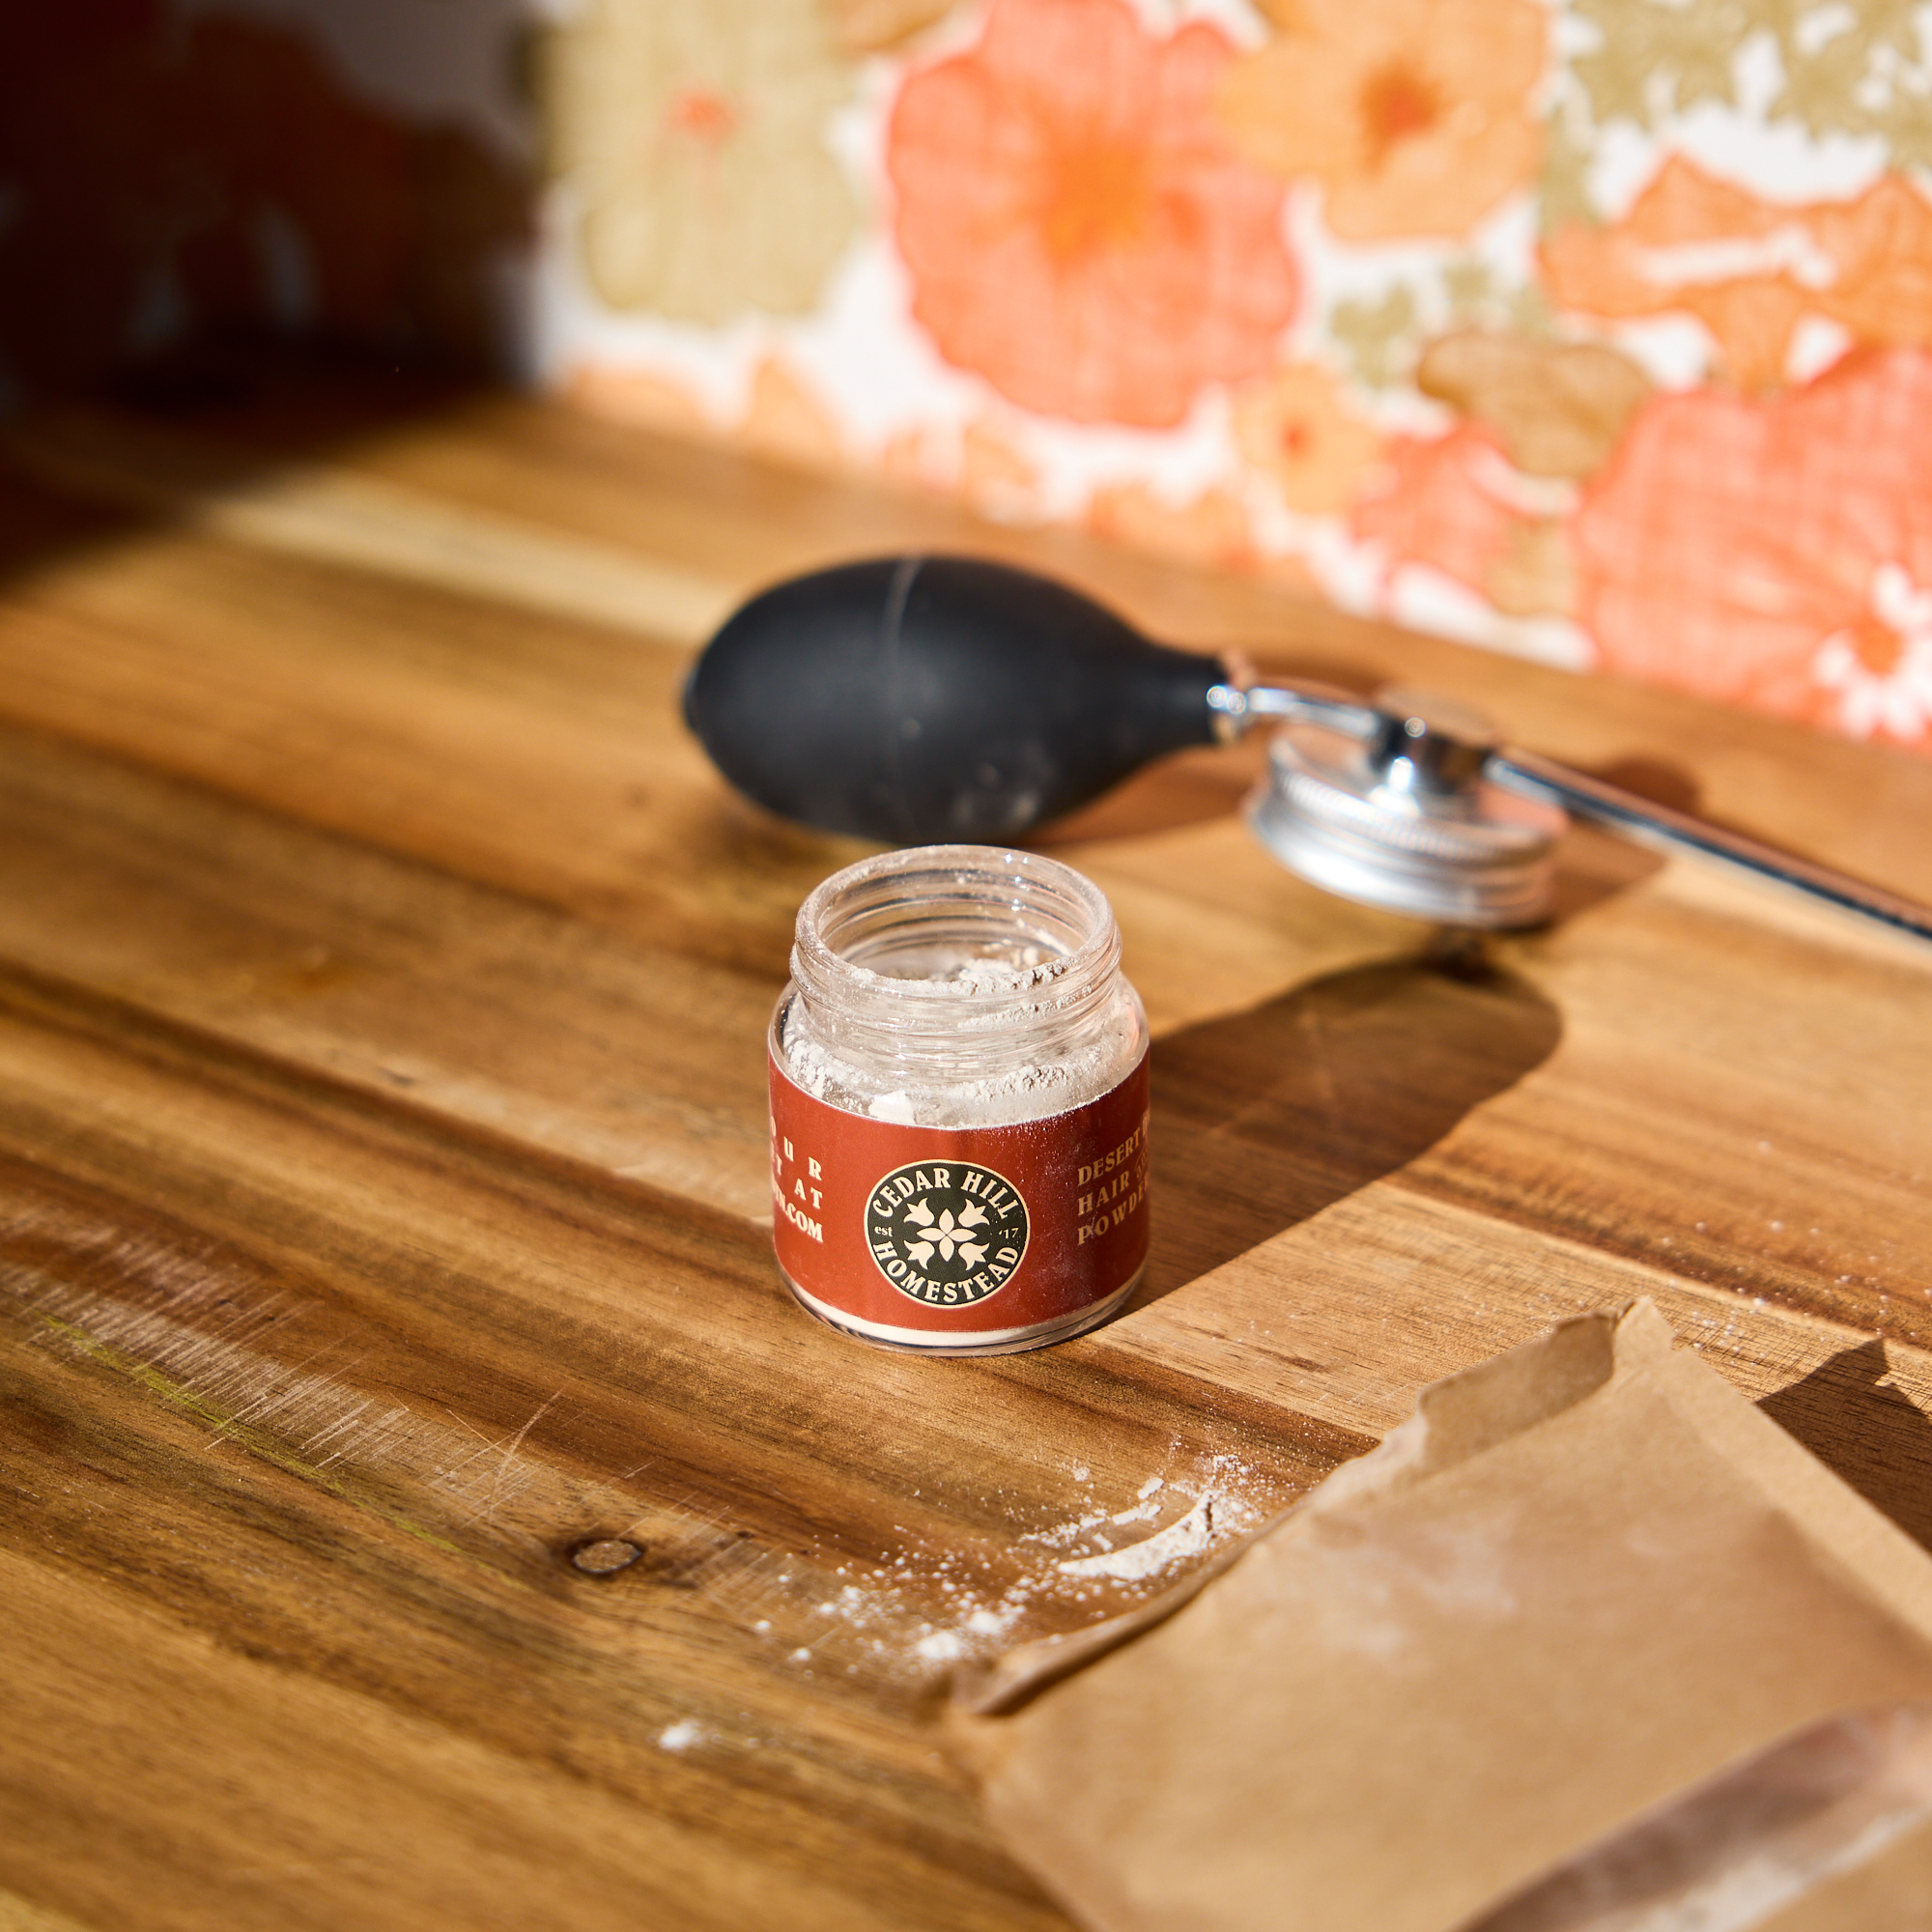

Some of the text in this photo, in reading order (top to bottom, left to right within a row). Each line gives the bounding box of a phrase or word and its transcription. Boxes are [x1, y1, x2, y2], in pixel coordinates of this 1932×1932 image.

[1078, 1126, 1141, 1187] DESERT
[794, 1178, 823, 1209] AT
[872, 1167, 1019, 1219] CEDAR HILL
[1077, 1170, 1130, 1216] HAIR
[874, 1226, 894, 1237] est
[872, 1240, 1019, 1303] HOMESTEAD
